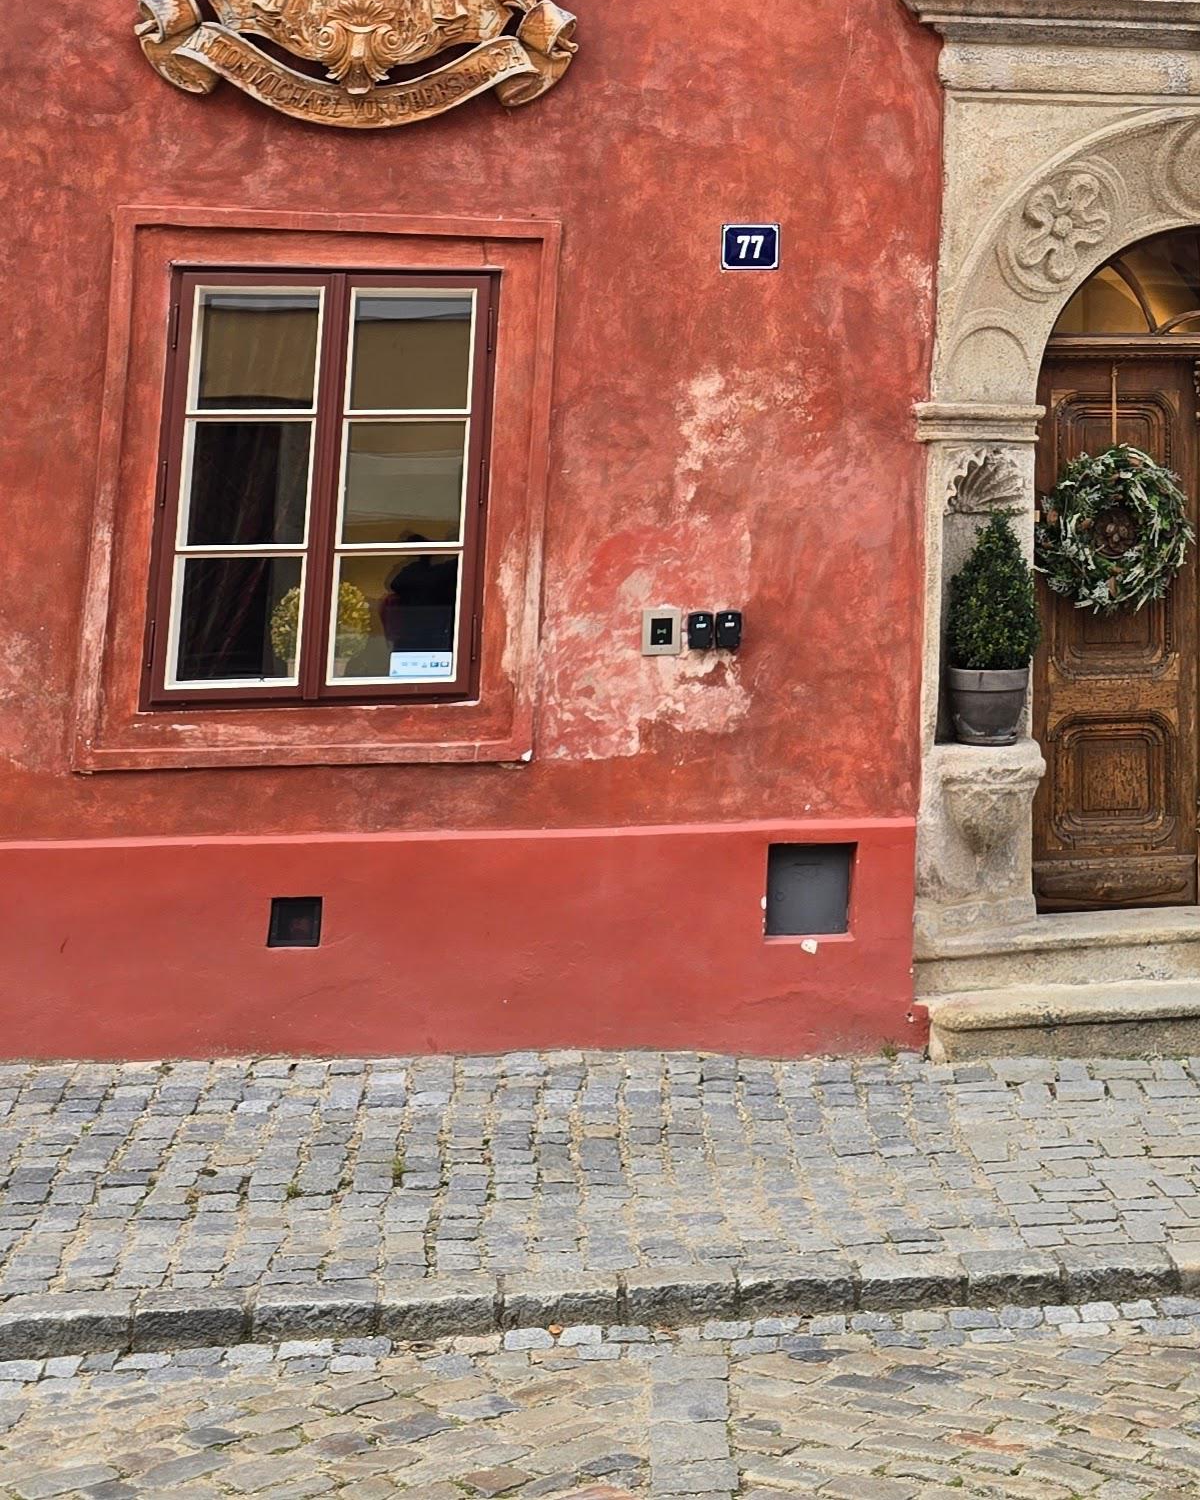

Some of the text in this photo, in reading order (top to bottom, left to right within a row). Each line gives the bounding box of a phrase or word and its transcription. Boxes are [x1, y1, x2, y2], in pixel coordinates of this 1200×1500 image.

[180, 35, 526, 118] ANTON MICHAEL VON EBERSBACH
[737, 235, 764, 259] 77
